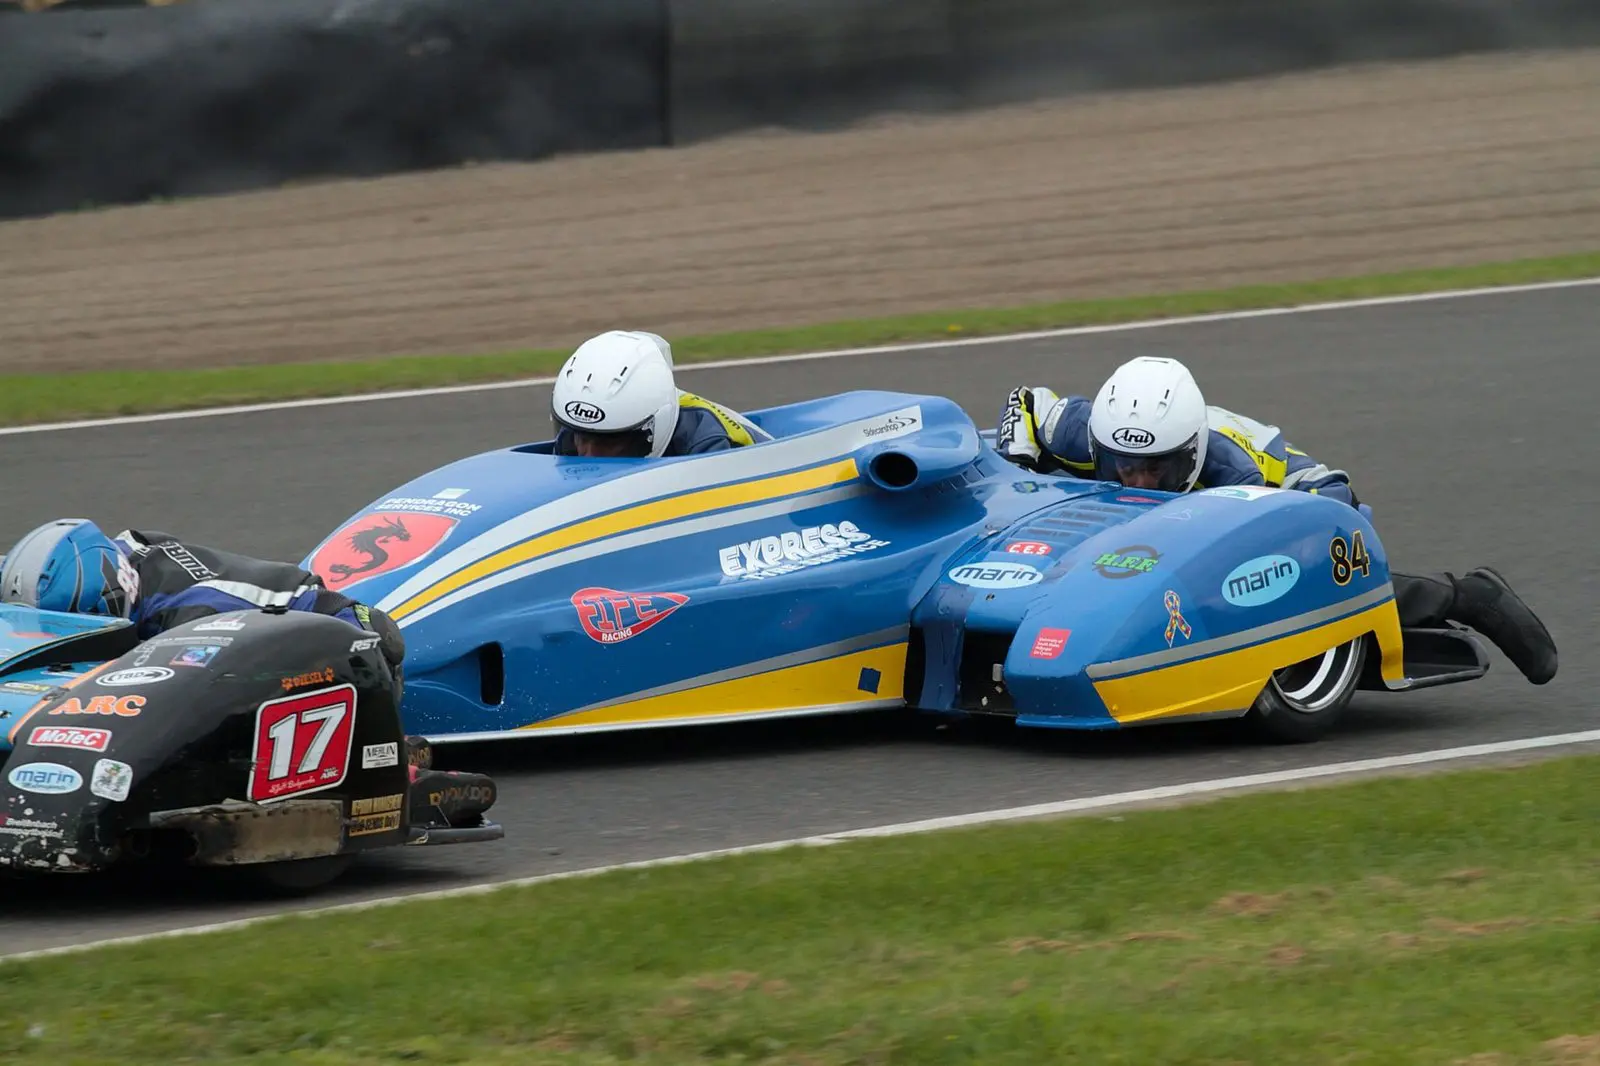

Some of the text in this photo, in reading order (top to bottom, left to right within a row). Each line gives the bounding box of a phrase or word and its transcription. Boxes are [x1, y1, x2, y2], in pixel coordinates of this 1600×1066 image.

[567, 403, 600, 419] Arai
[1113, 430, 1150, 444] Arai
[374, 503, 472, 516] SERVICES INC
[383, 498, 482, 511] PENDRAGON
[718, 520, 871, 577] EXPRESS
[1329, 529, 1370, 587] 84
[954, 566, 1038, 583] marin
[1228, 561, 1293, 599] marin
[579, 594, 658, 632] FIFE
[601, 627, 633, 642] RACING
[349, 636, 382, 653] RST
[48, 694, 147, 717] ARC
[36, 730, 101, 746] MoTeC
[268, 702, 347, 781] 17
[364, 745, 396, 759] MERLIN
[15, 769, 75, 784] marin
